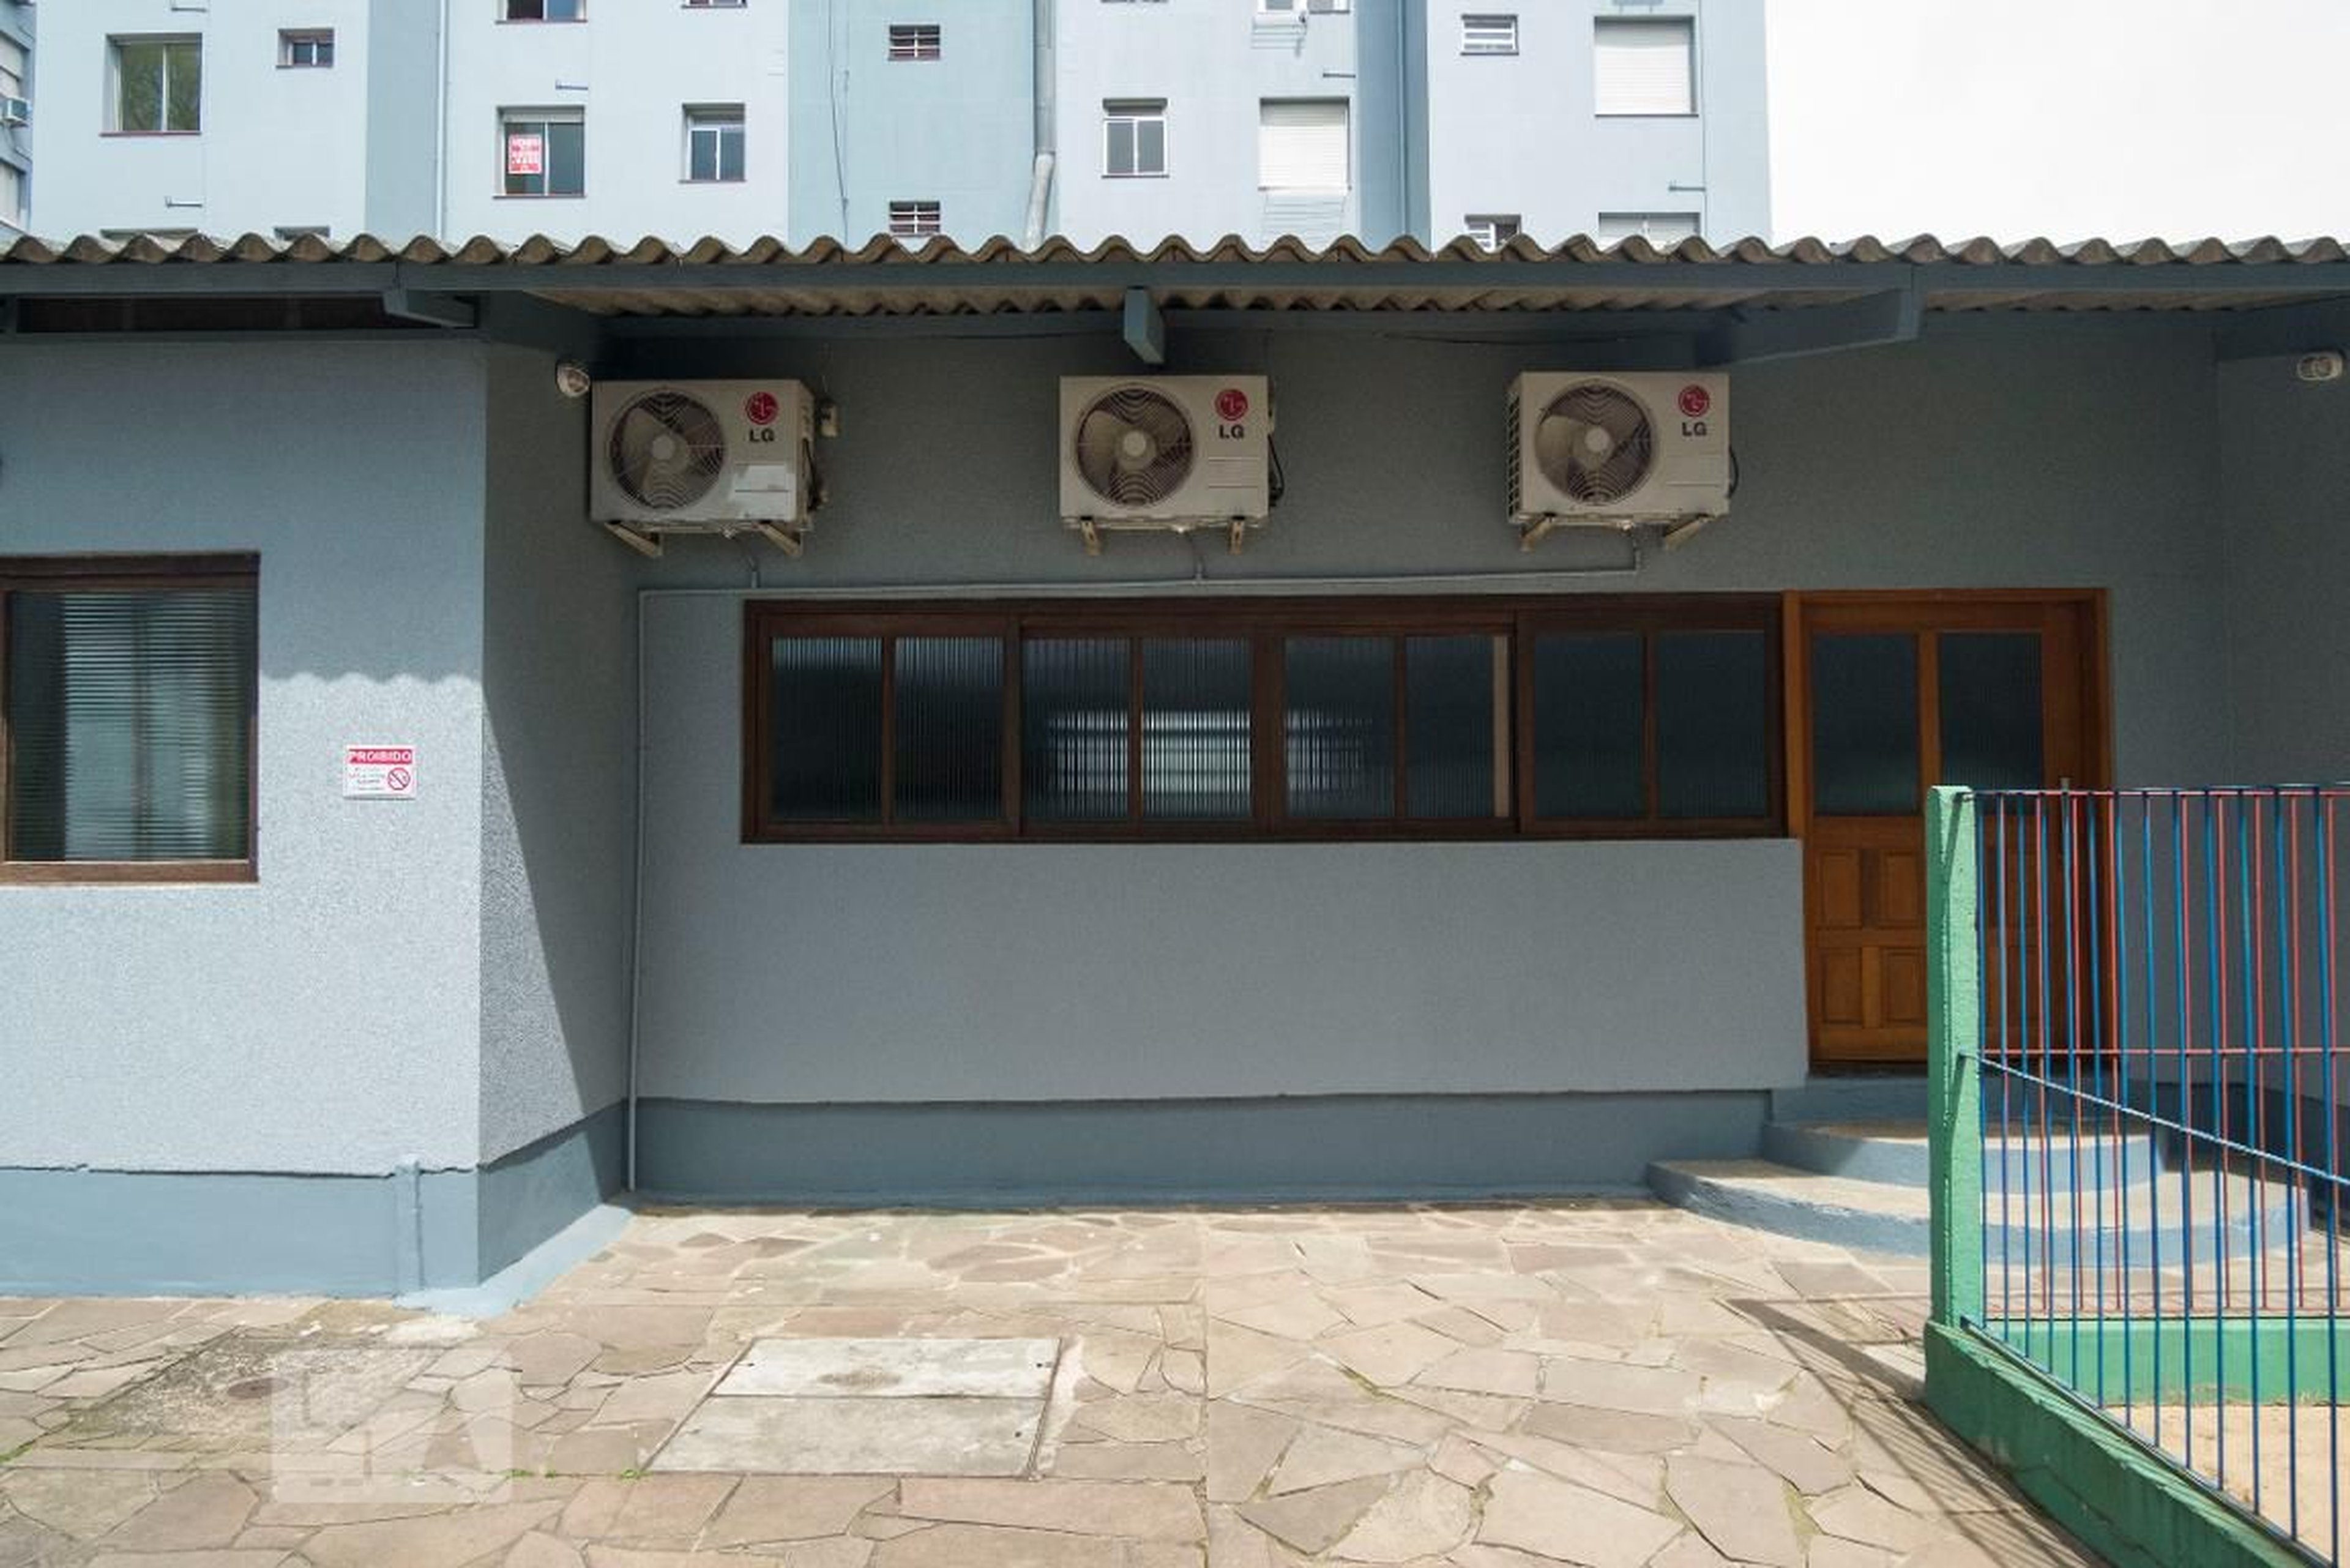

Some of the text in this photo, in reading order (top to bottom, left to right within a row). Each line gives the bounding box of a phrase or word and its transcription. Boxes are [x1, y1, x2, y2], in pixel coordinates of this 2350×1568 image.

[748, 428, 775, 442] LG
[1218, 424, 1245, 439] LG
[1681, 421, 1707, 437] LG
[348, 750, 412, 762] PROIBIDO
